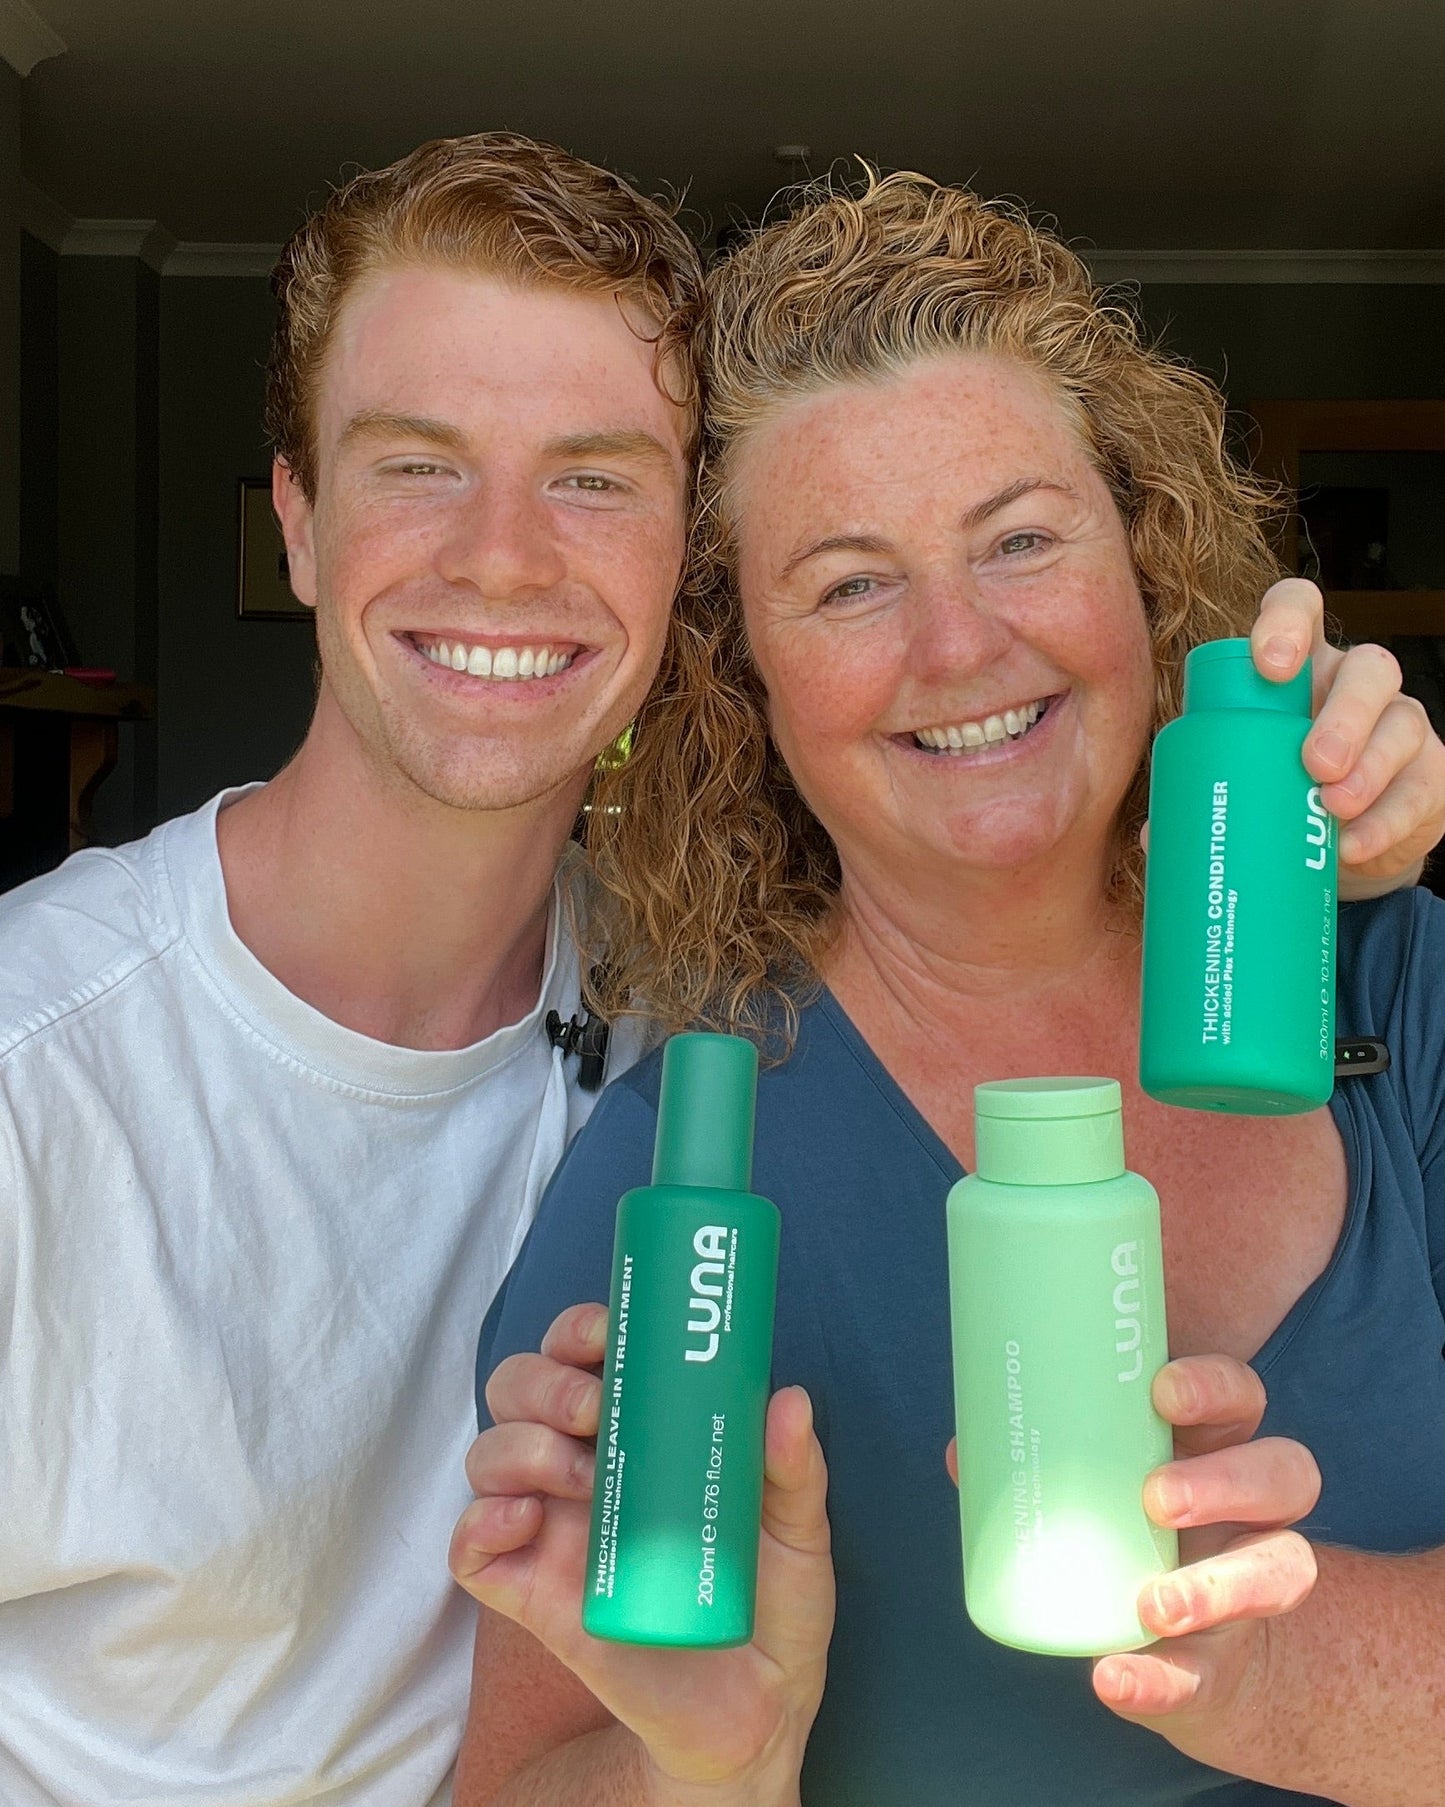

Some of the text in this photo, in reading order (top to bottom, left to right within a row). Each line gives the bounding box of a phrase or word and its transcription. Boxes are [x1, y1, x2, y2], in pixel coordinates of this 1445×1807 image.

[1305, 786, 1328, 871] LUN
[1202, 780, 1228, 1045] THICKENING CONDITIONER
[1323, 888, 1332, 914] net
[1221, 888, 1238, 1045] with added Plex Technology
[1320, 1007, 1330, 1061] 300ml
[684, 1225, 728, 1362] LUNA
[724, 1228, 738, 1332] professional haircare
[1111, 1241, 1143, 1383] LUNA
[596, 1254, 634, 1596] THICKENING LEAVE-IN TREATMENT
[711, 1413, 726, 1442] net
[1006, 1340, 1025, 1463] SHAMPOO
[703, 1484, 720, 1519] 6.76
[1030, 1428, 1042, 1505] Technology
[607, 1450, 626, 1598] with added Plex Technology
[697, 1547, 716, 1607] 200ml
